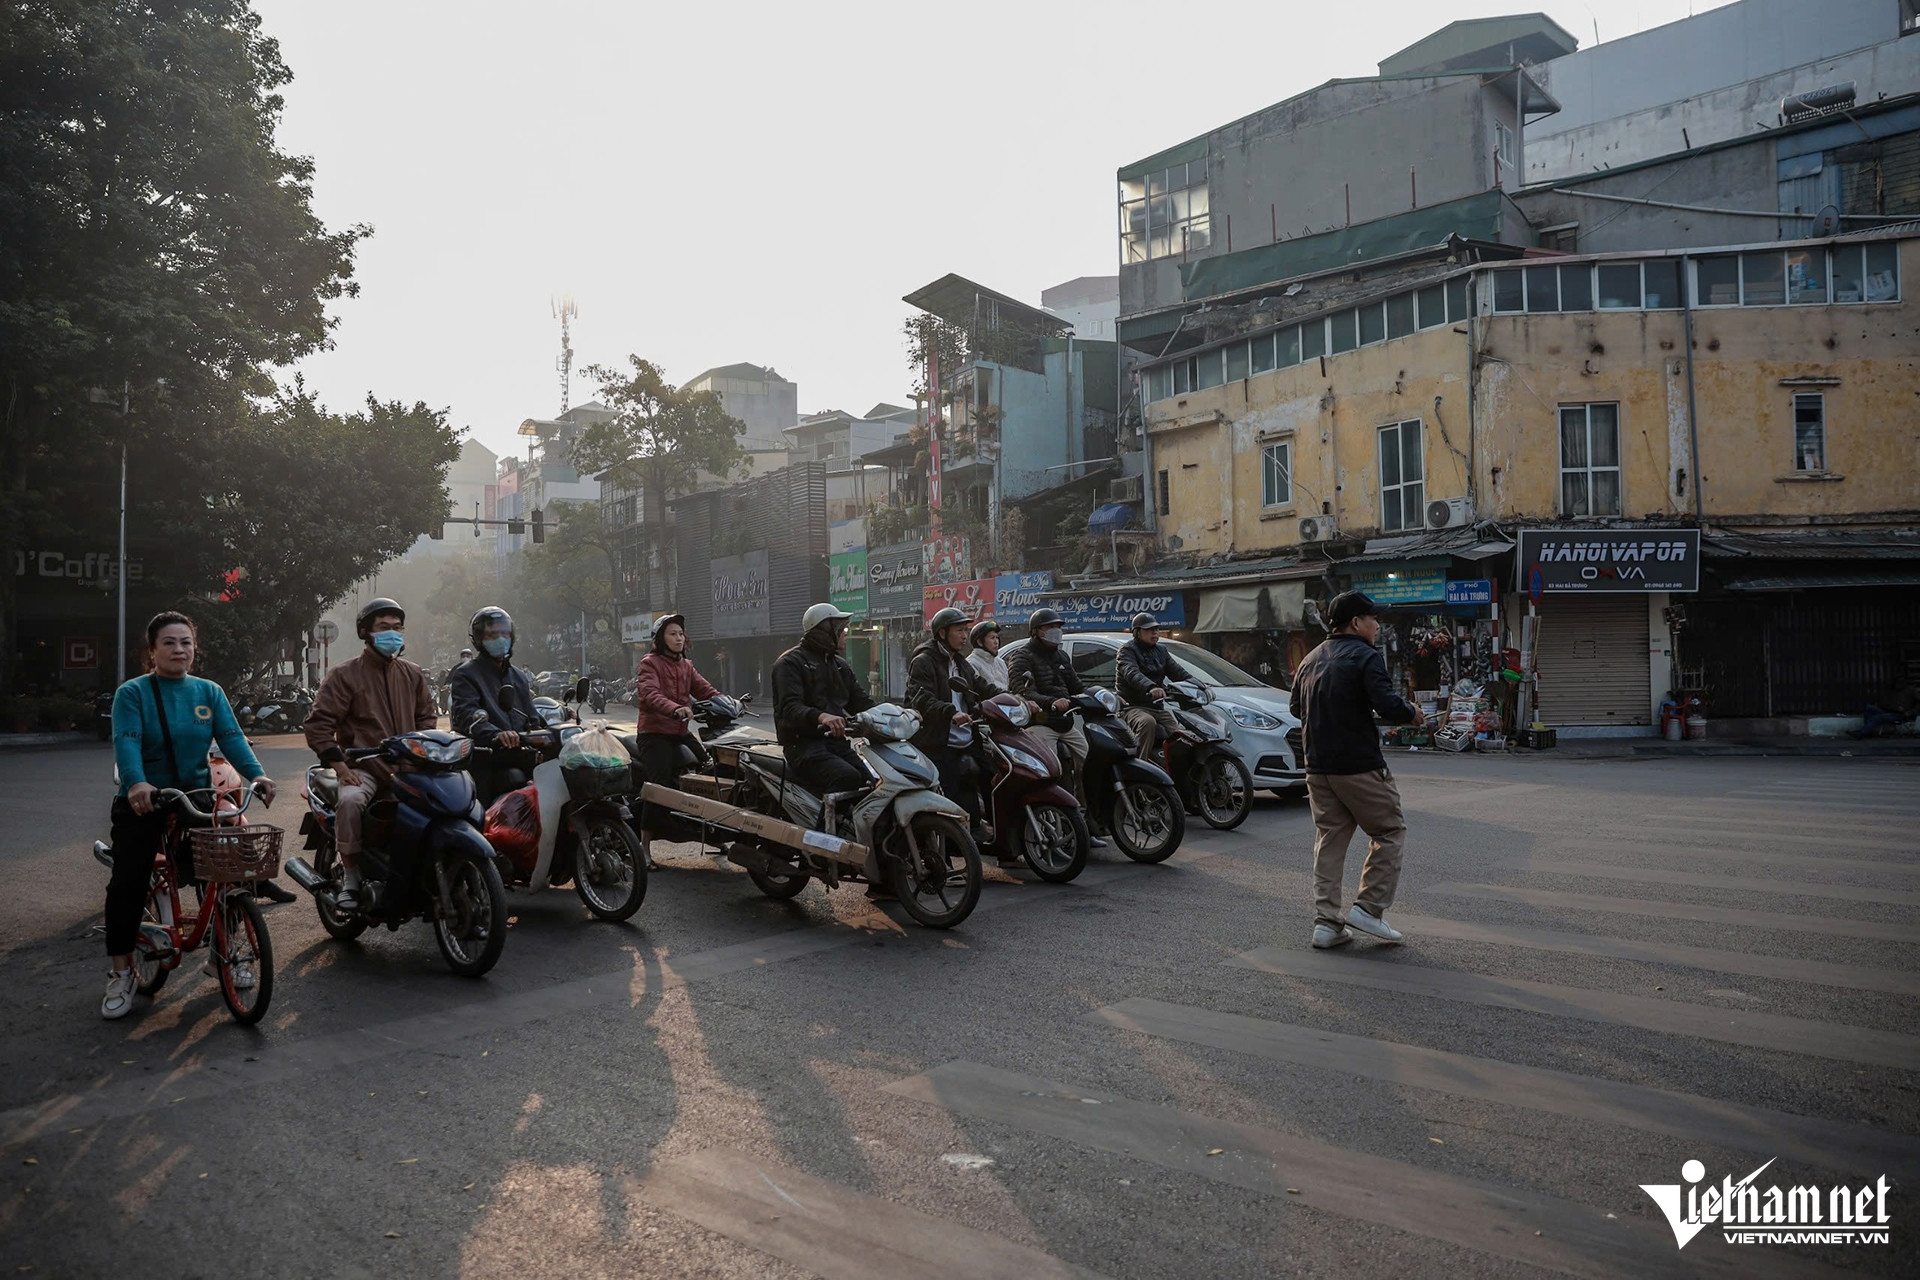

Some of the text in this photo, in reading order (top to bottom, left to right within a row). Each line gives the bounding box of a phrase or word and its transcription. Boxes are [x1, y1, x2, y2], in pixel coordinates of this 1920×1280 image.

[1540, 542, 1688, 562] HANOI VAPOR
[1090, 594, 1173, 614] Flower
[1449, 593, 1459, 601] HAI
[1460, 590, 1468, 601] BÀ
